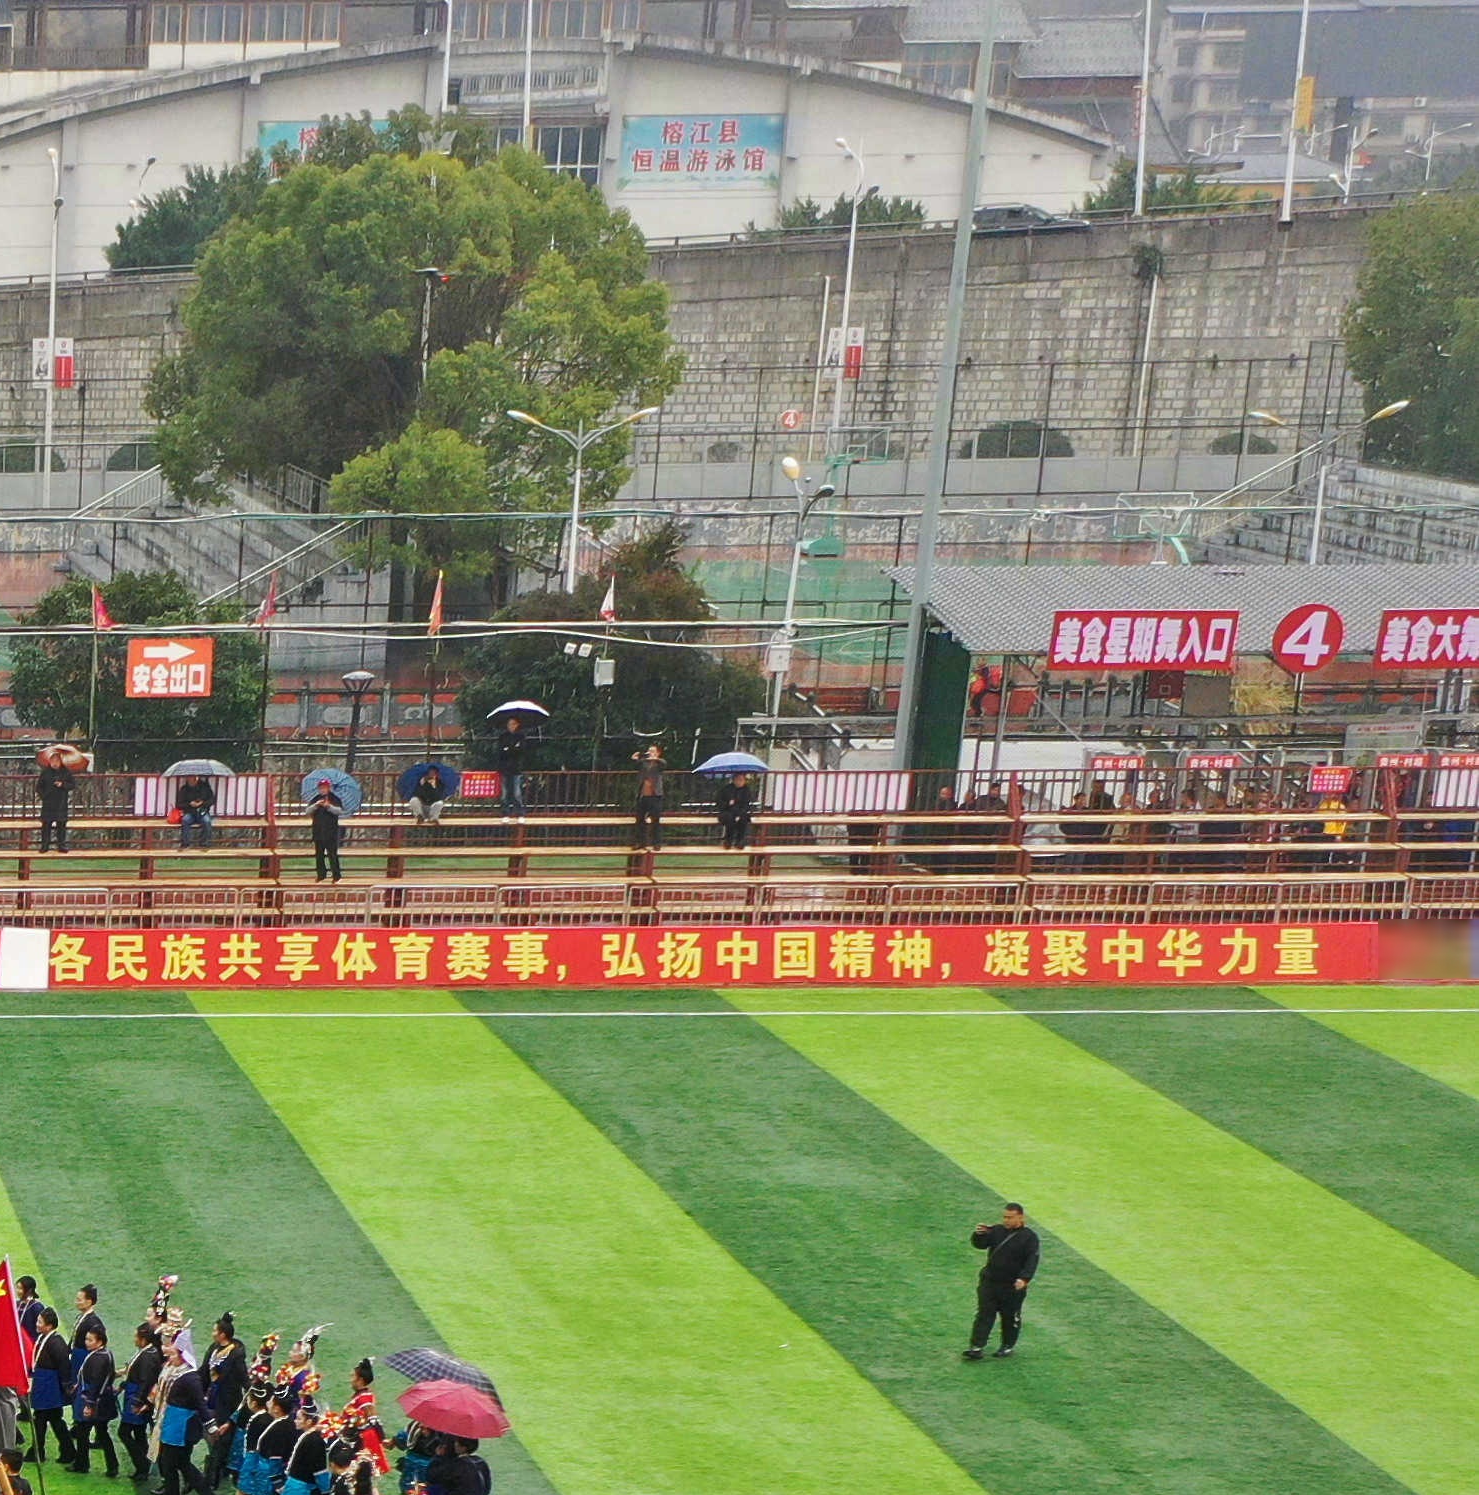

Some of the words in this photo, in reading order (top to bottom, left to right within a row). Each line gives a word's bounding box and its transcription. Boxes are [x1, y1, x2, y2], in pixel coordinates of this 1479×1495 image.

[661, 119, 741, 145] 榕江县
[631, 147, 767, 173] 恒温游泳馆
[1281, 611, 1330, 666] 4
[132, 662, 207, 696] 安全出口
